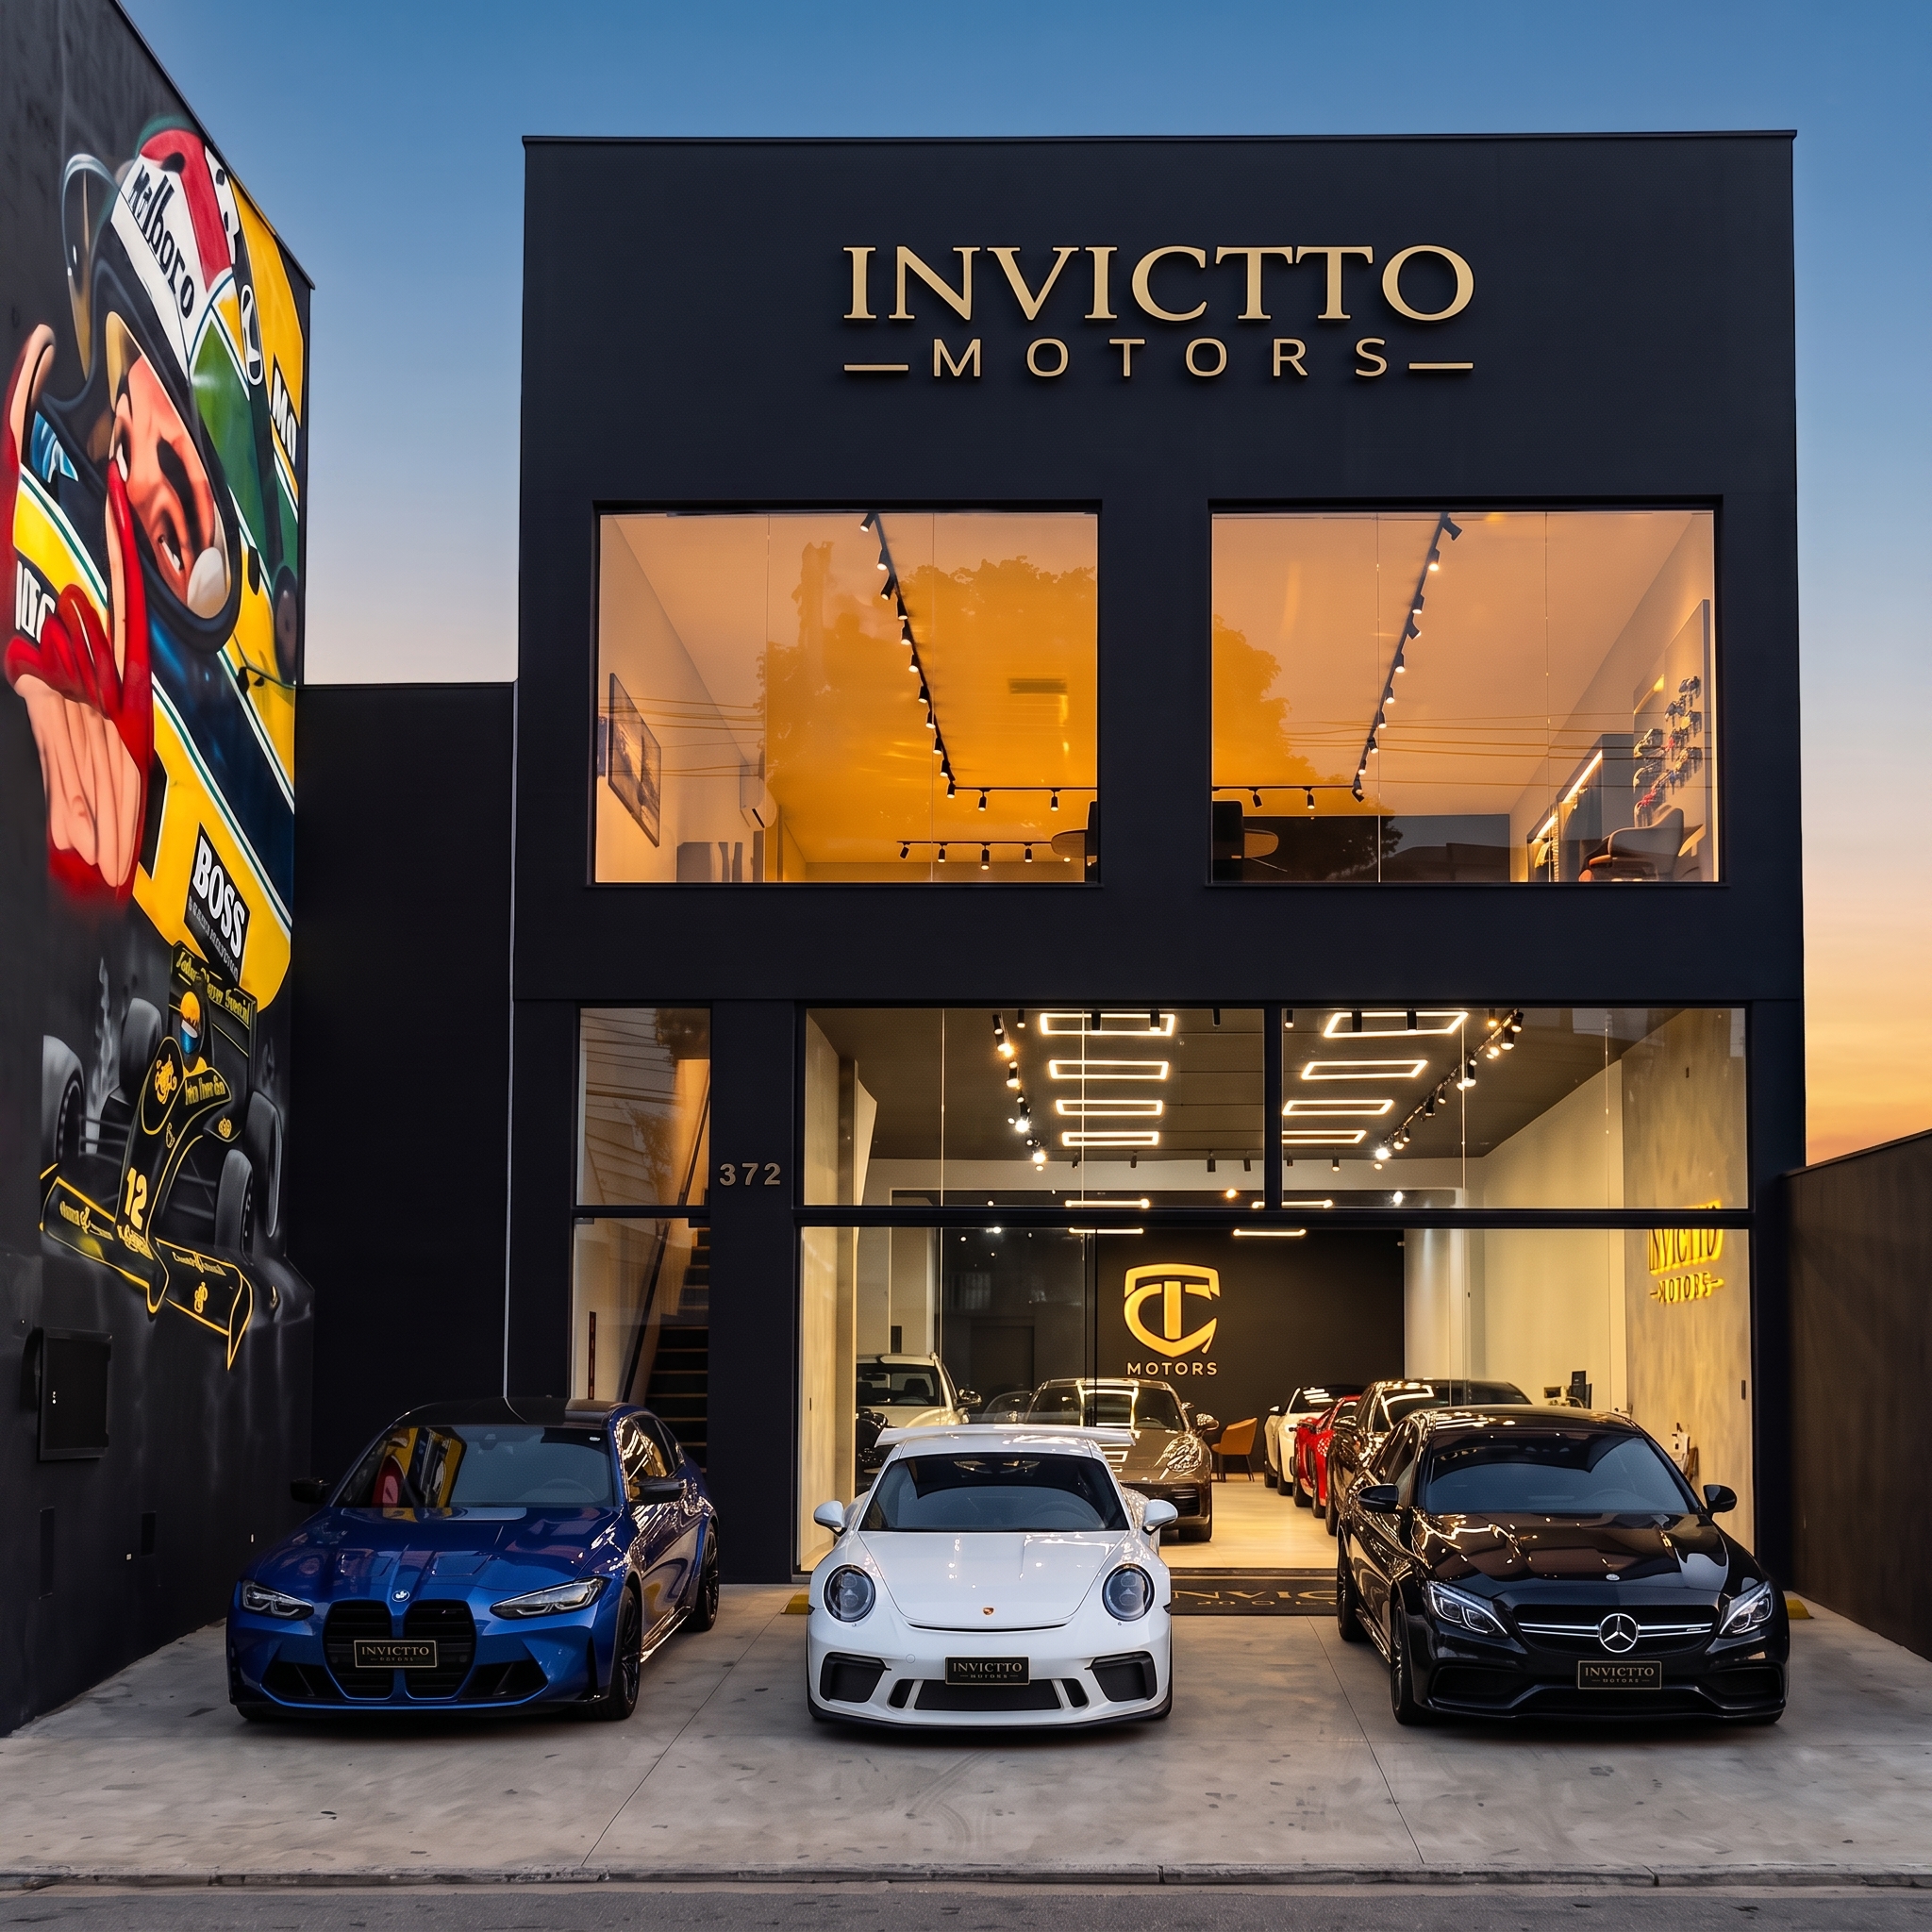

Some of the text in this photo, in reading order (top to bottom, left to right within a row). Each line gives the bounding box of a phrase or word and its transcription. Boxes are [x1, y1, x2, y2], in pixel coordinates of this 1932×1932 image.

[843, 244, 1474, 322] INVICTTO
[933, 337, 1388, 377] MOTORS
[192, 835, 245, 958] BOSS
[719, 1162, 781, 1186] 372
[125, 1167, 147, 1230] 12
[1126, 1362, 1218, 1375] MOTORS
[361, 1646, 430, 1656] INVICTTO
[953, 1662, 1023, 1673] INVICTTO
[1585, 1667, 1655, 1676] INVICTTO
